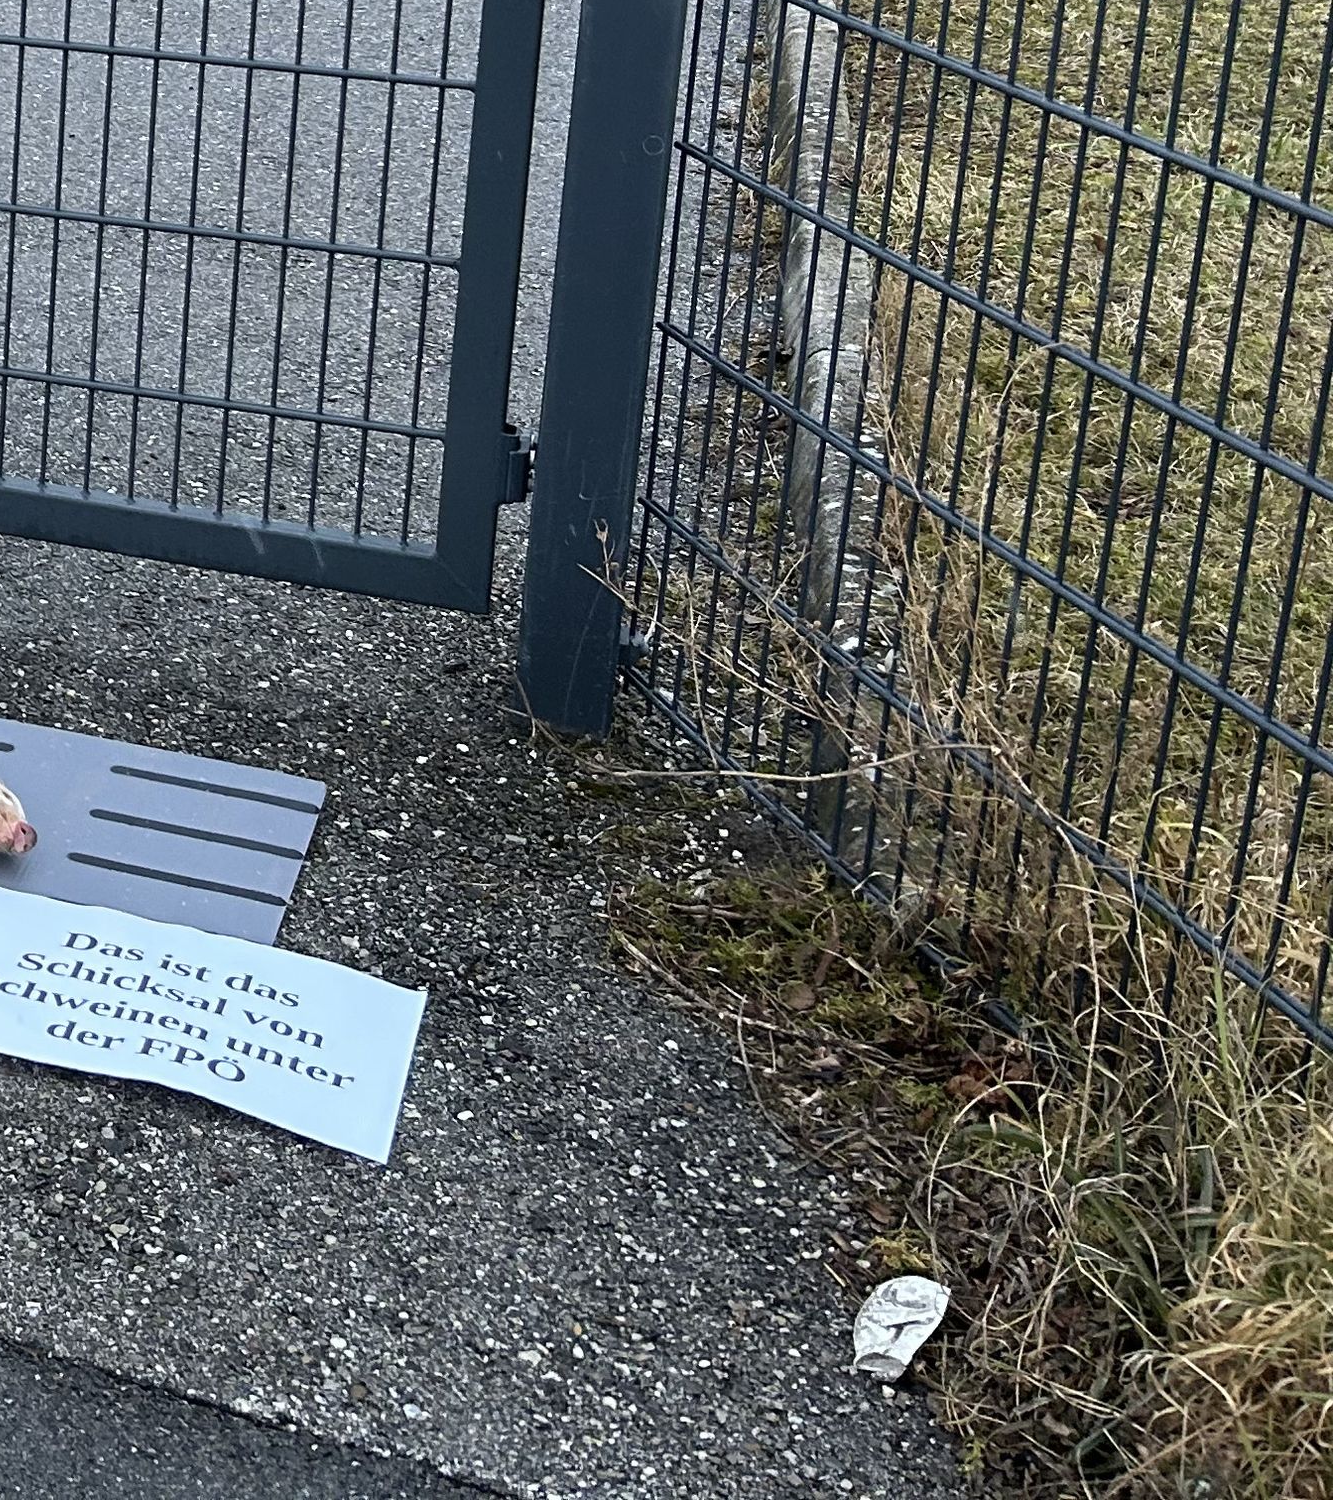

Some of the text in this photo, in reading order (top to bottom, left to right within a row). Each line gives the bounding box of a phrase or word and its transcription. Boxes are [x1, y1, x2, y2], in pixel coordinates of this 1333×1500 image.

[17, 952, 325, 1050] Schicksal von
[62, 931, 300, 1008] Das ist das
[46, 1019, 247, 1084] der FPÖ
[227, 1035, 356, 1090] unter
